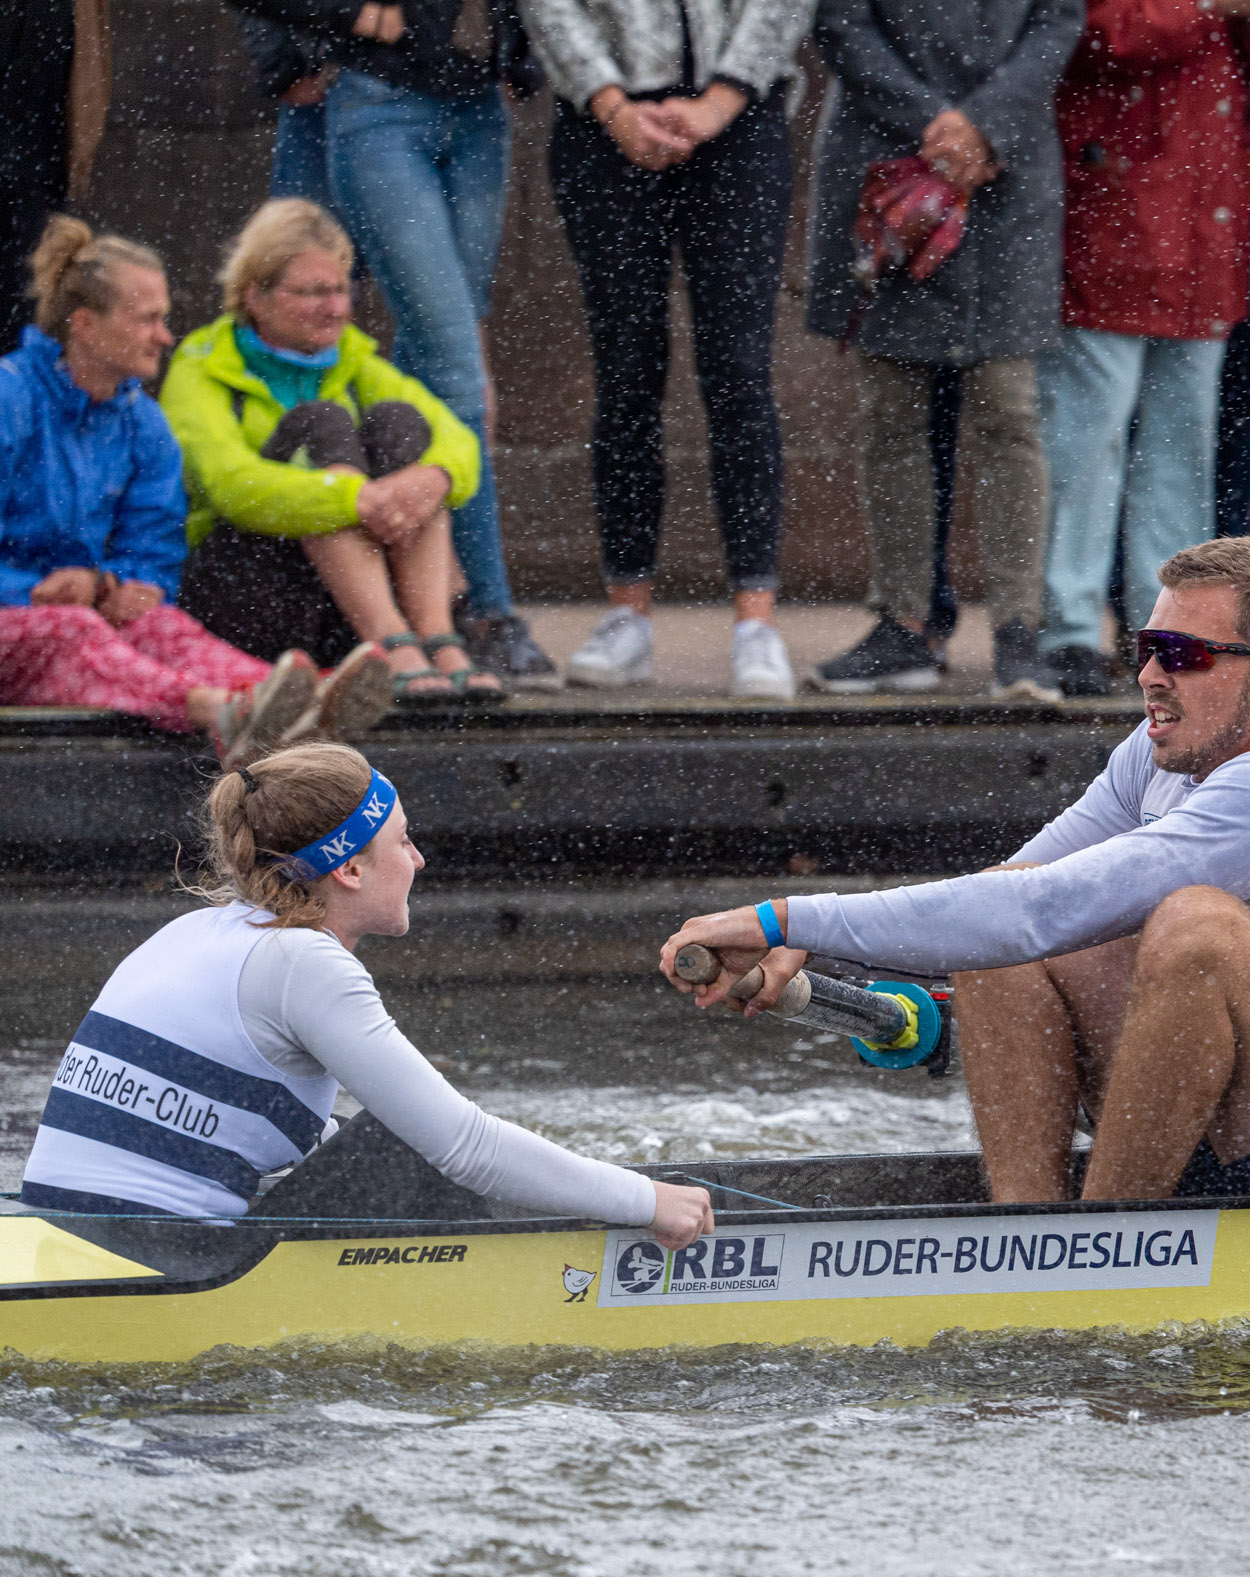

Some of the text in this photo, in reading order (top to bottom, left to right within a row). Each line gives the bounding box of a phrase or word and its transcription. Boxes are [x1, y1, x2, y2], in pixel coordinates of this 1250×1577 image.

[361, 791, 389, 828] NK
[319, 829, 357, 864] NK
[56, 1047, 219, 1138] der Ruder-Club
[337, 1245, 468, 1266] EMPACHER
[672, 1237, 779, 1281] RBL
[807, 1229, 1199, 1278] RUDER-BUNDESLIGA
[670, 1278, 776, 1293] RUDER-BUNDESLIGA
